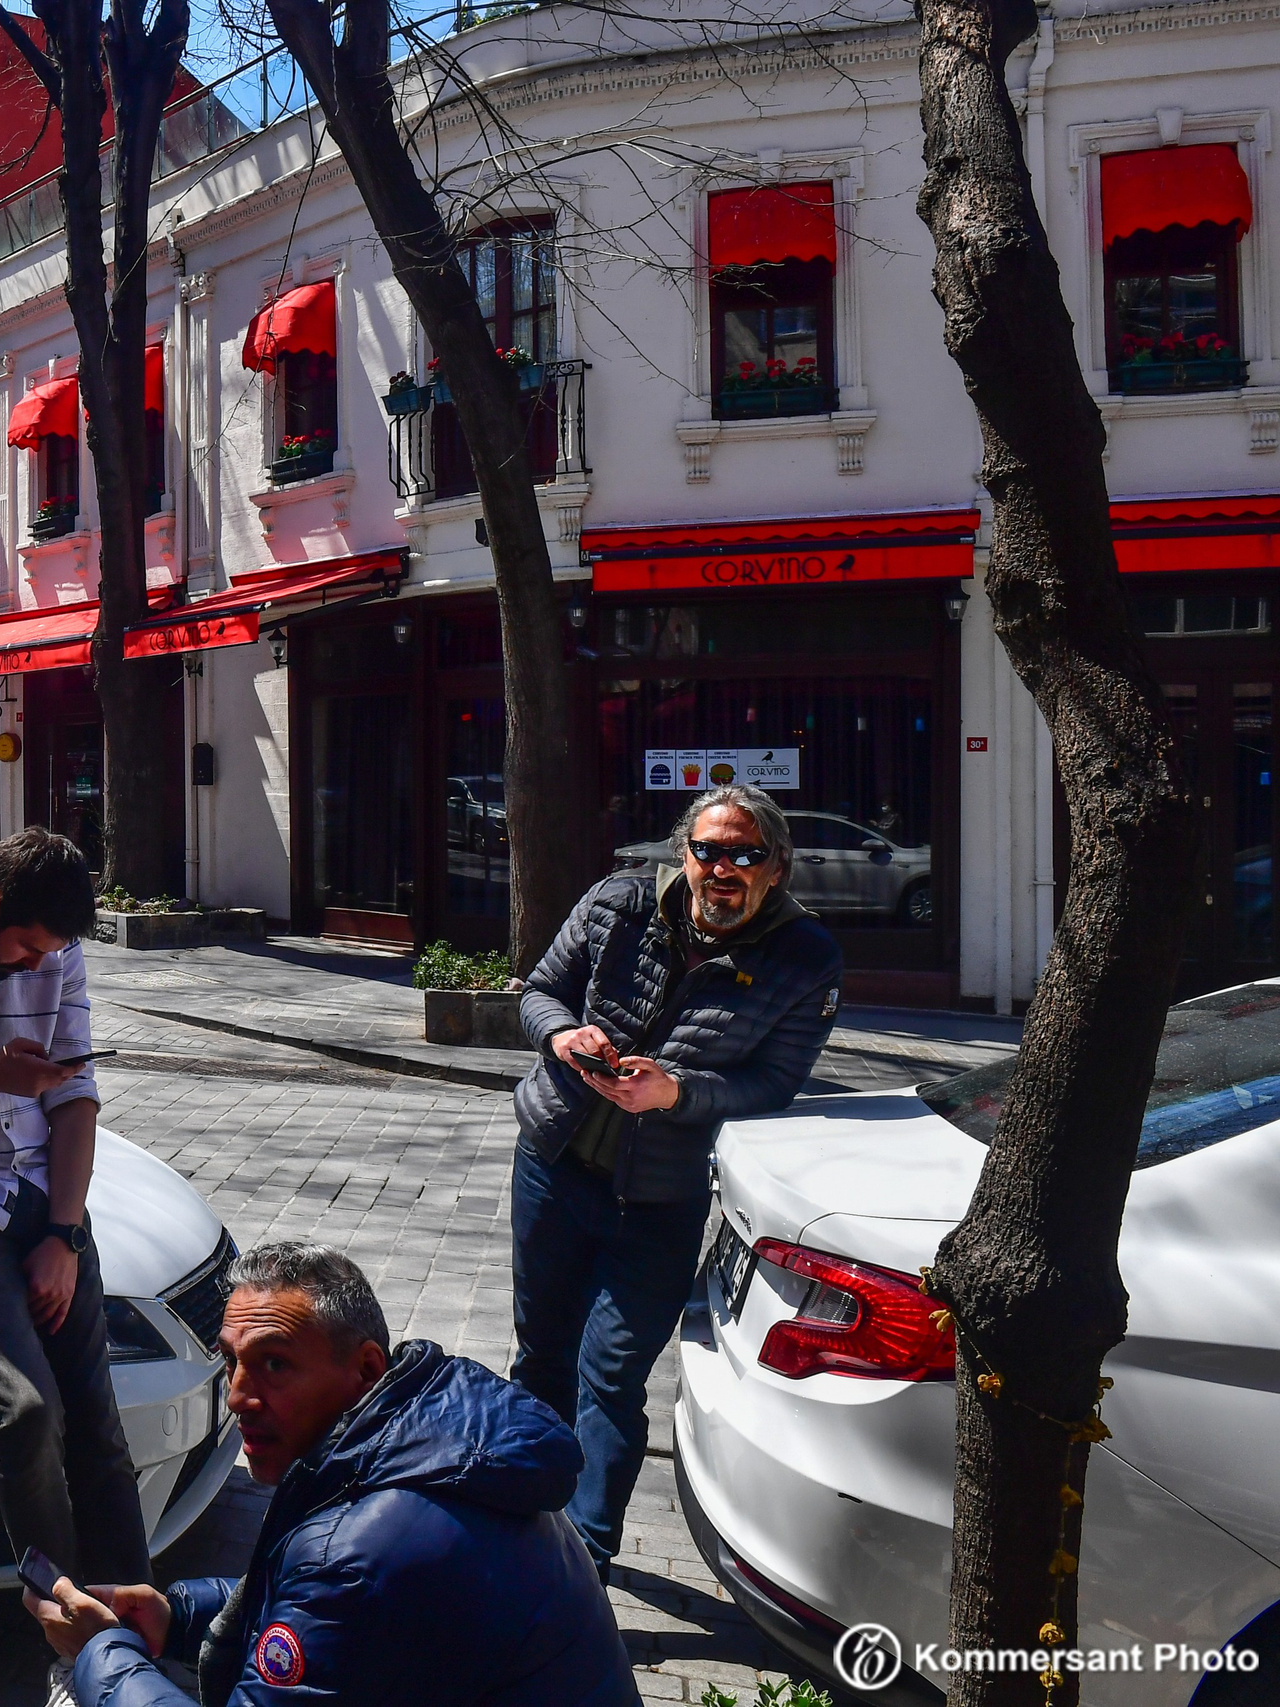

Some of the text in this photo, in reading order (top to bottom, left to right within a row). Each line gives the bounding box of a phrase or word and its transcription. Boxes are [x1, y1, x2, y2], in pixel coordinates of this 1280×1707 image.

[701, 556, 826, 583] CORVINO
[149, 624, 211, 651] CORVINO
[746, 767, 790, 776] CORVINO
